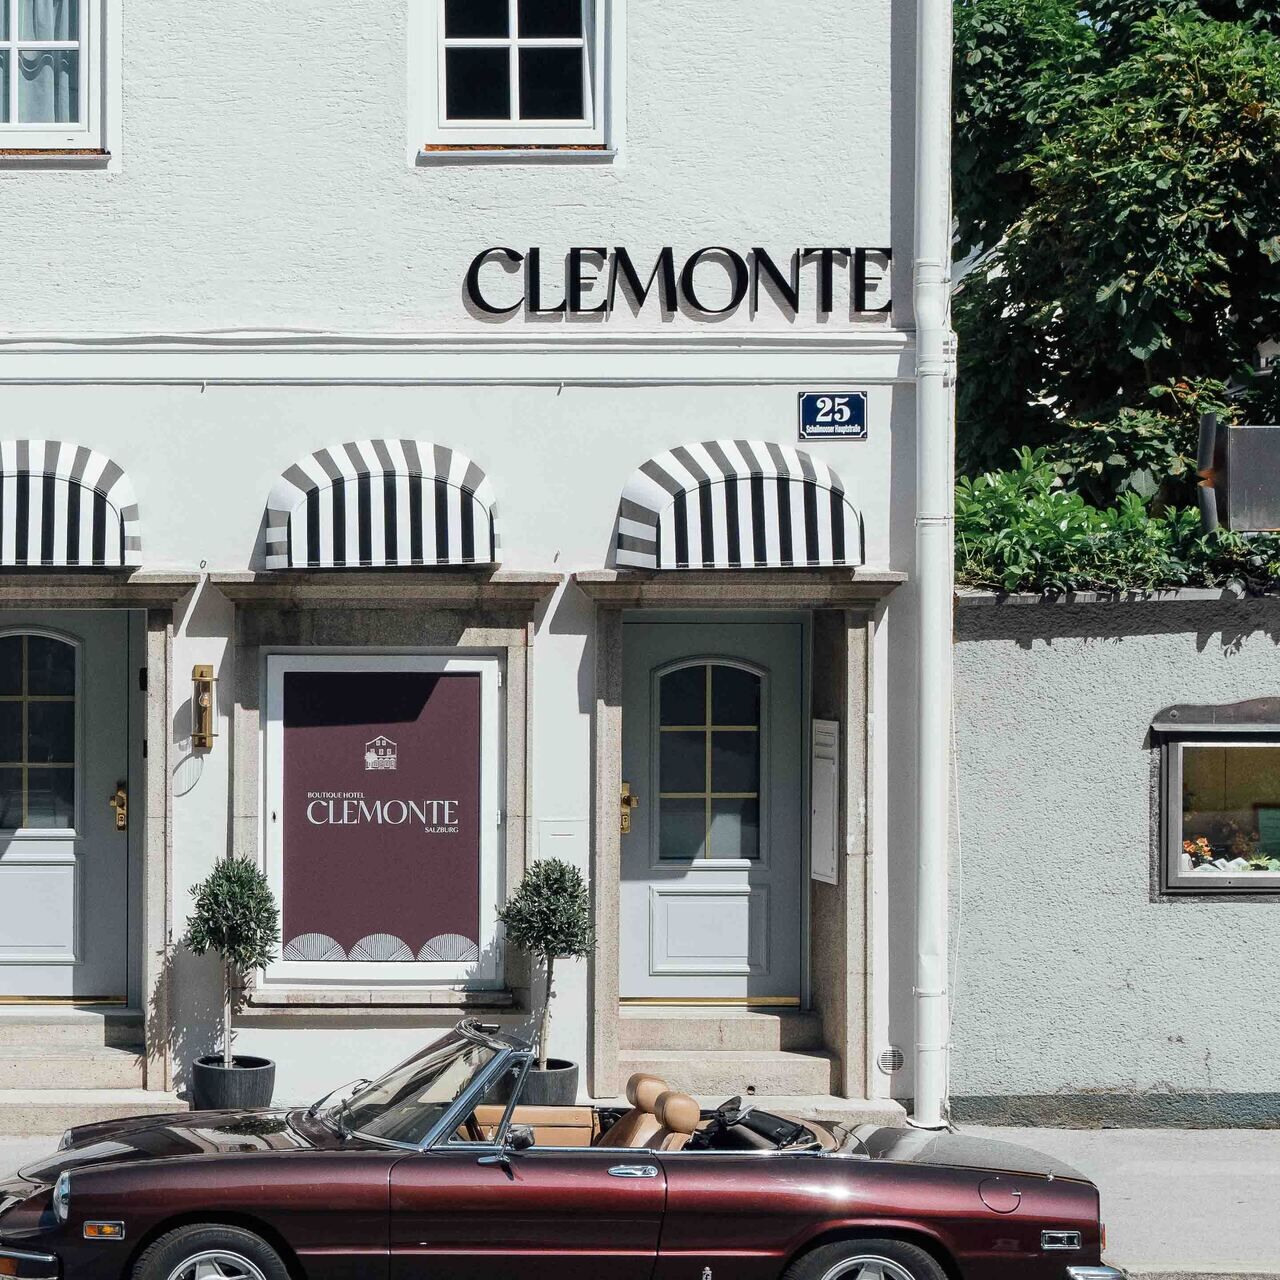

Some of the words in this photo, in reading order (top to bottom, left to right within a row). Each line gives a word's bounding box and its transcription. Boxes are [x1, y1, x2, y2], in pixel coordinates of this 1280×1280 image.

[465, 245, 893, 314] CLEMONTE
[815, 397, 851, 422] 25
[306, 799, 459, 825] CLEMONTE
